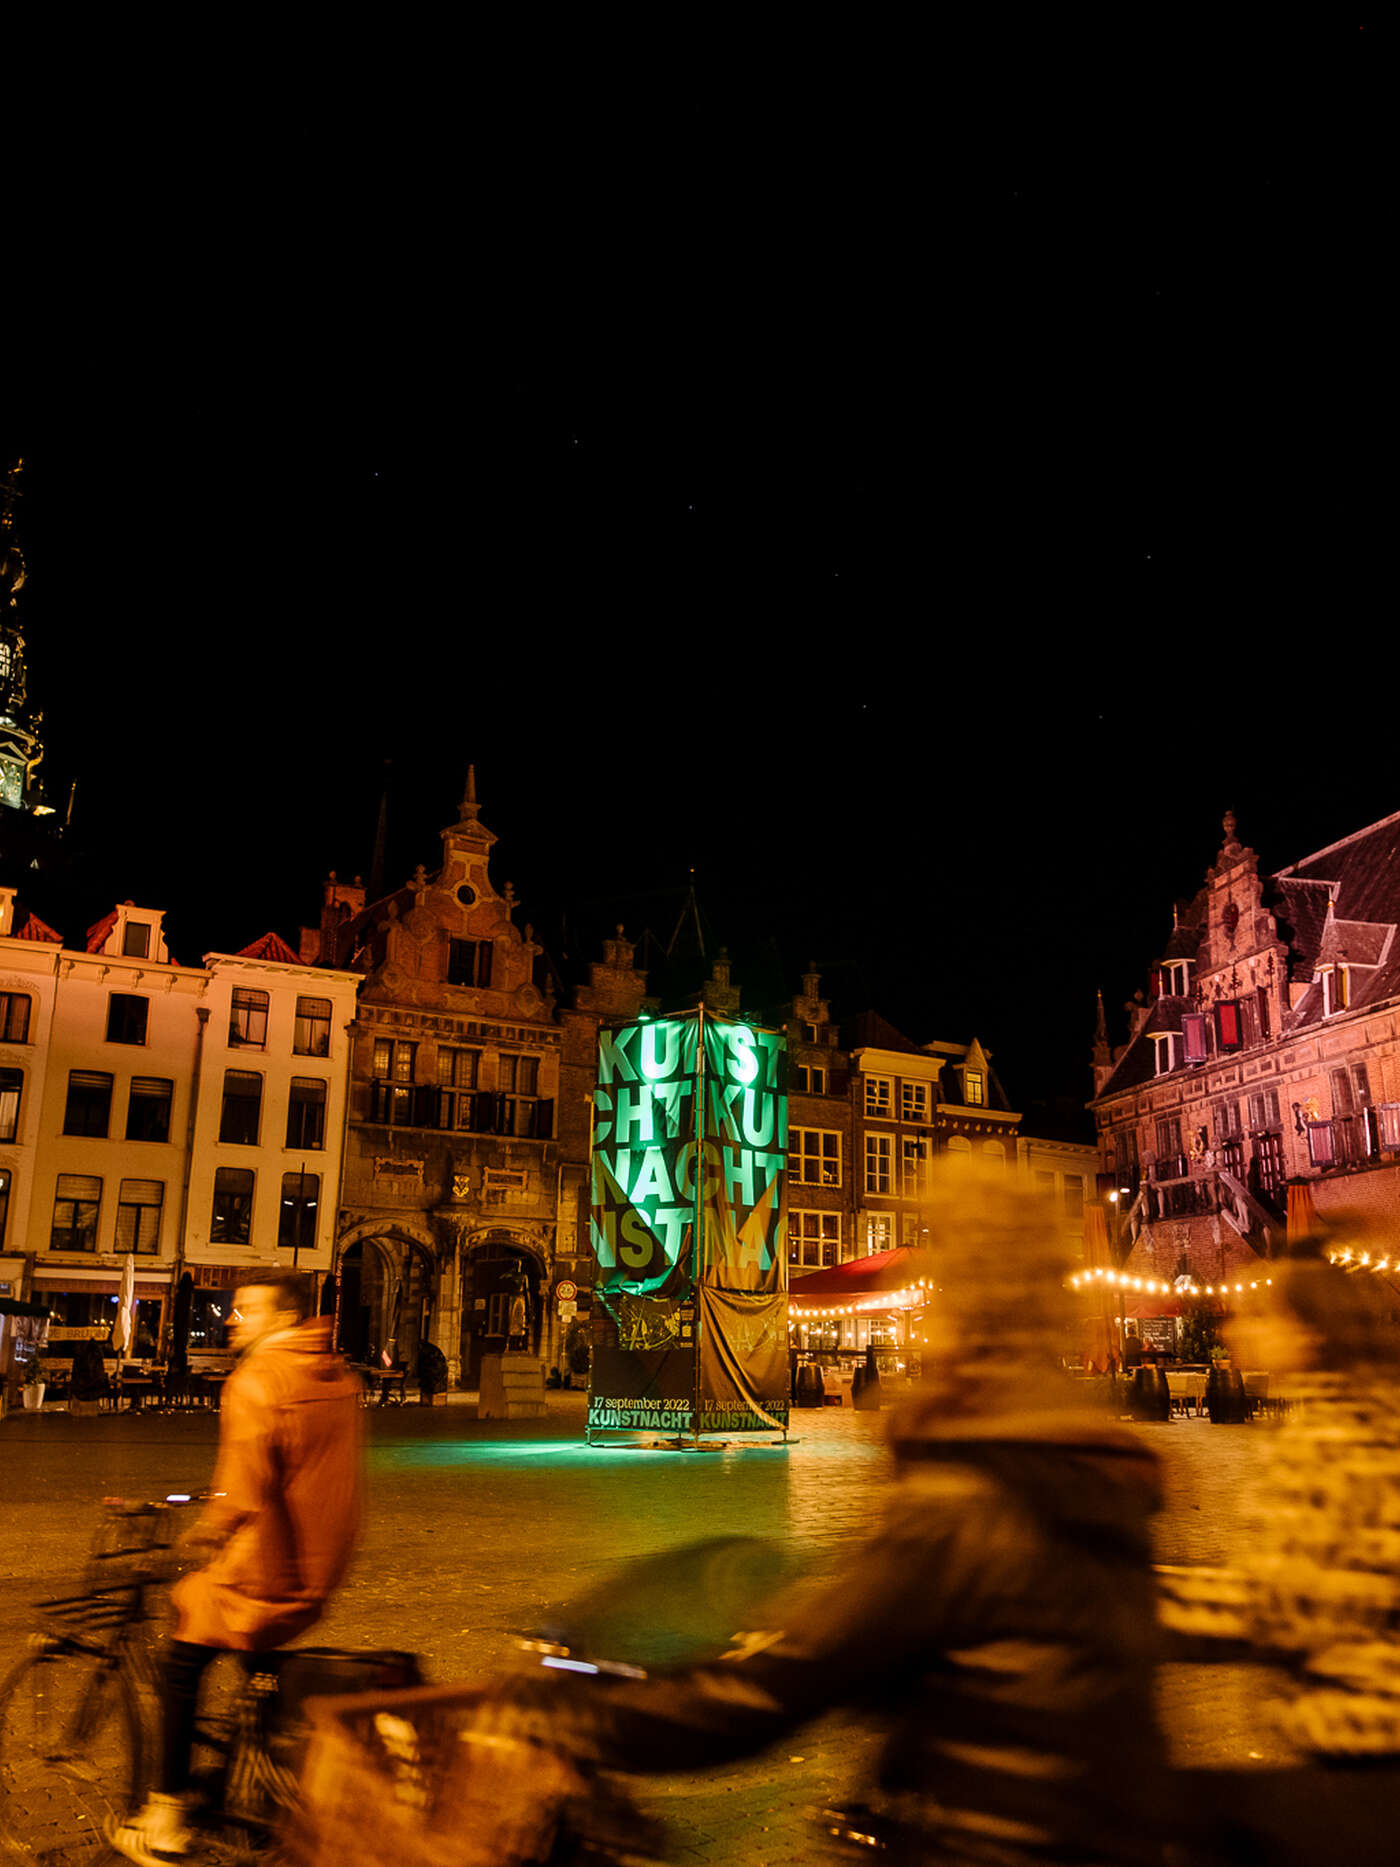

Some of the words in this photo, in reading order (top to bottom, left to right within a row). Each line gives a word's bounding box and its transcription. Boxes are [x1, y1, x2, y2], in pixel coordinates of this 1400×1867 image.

[594, 1396, 605, 1408] 17
[605, 1397, 661, 1411] september
[663, 1399, 690, 1411] 2022
[704, 1400, 714, 1411] 17
[765, 1400, 785, 1411] 2022
[588, 1408, 694, 1428] KUNSTNACHT
